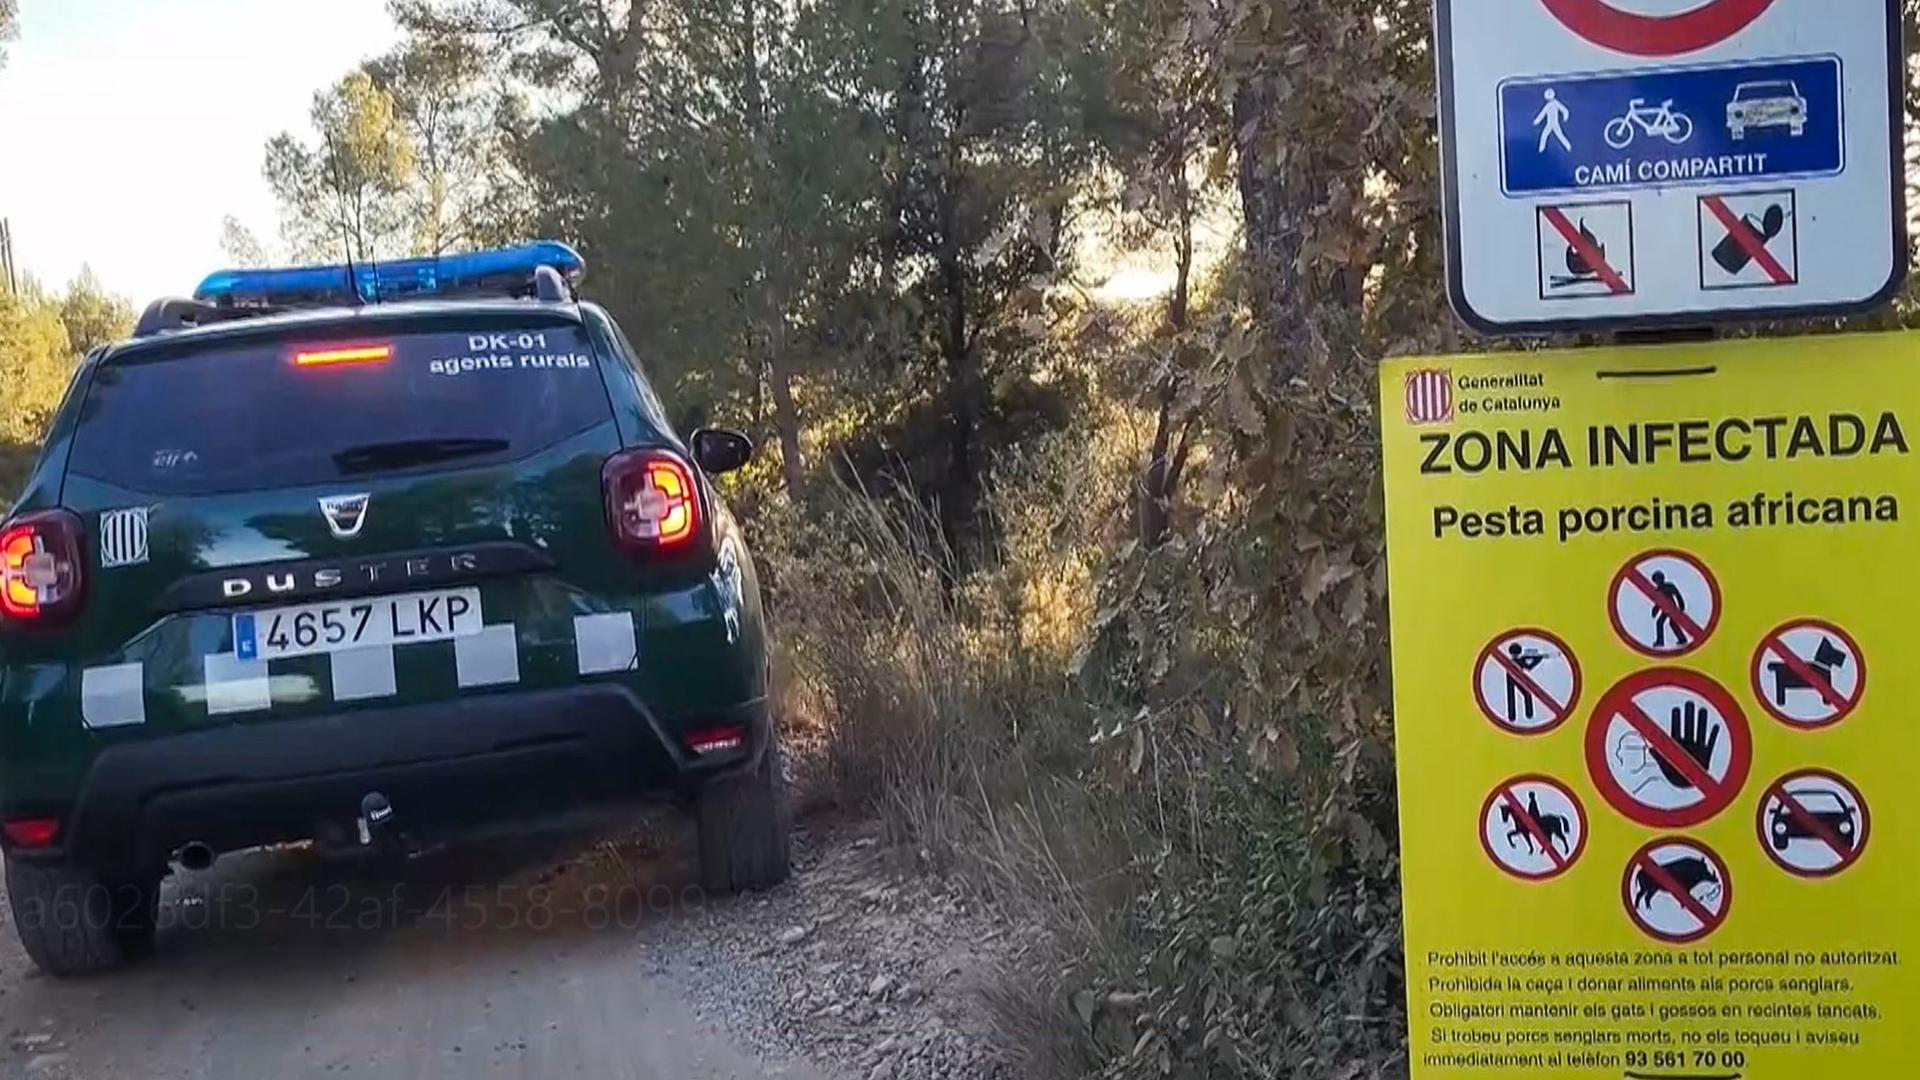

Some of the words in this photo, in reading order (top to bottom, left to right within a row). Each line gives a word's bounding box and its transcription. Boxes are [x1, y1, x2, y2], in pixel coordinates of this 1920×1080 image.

[1574, 160, 1631, 185] CAMÍ
[1638, 153, 1768, 181] COMPARTIT
[468, 333, 546, 352] DK-01
[430, 353, 513, 375] agents
[520, 352, 590, 369] rurals
[1458, 372, 1544, 391] Generalitat
[1459, 397, 1478, 413] de
[1482, 394, 1560, 413] Catalunya
[1420, 427, 1572, 475] ZONA
[1588, 411, 1909, 467] INFECTADA
[1433, 503, 1544, 538] Pesta
[1559, 498, 1713, 541] porcina
[1727, 492, 1898, 528] africana
[223, 553, 476, 597] DUSTER
[267, 605, 372, 650] 4657
[391, 595, 470, 637] LKP
[1427, 951, 1487, 966] Prohibit
[1492, 950, 1546, 966] l'accés
[1551, 955, 1560, 966] a
[1566, 952, 1629, 969] aquesta
[1635, 954, 1672, 966] zona
[1678, 954, 1687, 965] a
[1694, 950, 1713, 965] tot
[1719, 950, 1789, 968] personal
[1795, 953, 1816, 965] no
[1429, 976, 1502, 991] Prohibida
[1508, 975, 1521, 991] la
[1526, 978, 1563, 995] caça
[1577, 976, 1623, 992] donar
[1628, 975, 1696, 992] aliments
[1701, 976, 1723, 991] als
[1729, 978, 1774, 995] porcs
[1779, 976, 1854, 996] senglars.
[1430, 1002, 1504, 1021] Obligatori
[1510, 1002, 1578, 1018] mantenir
[1583, 1002, 1606, 1018] els
[1611, 1003, 1645, 1021] gats
[1659, 1005, 1717, 1022] gossos
[1721, 1005, 1742, 1018] en
[1748, 1003, 1812, 1019] recintes
[1431, 1027, 1447, 1043] Si
[1452, 1028, 1501, 1043] trobeu
[1506, 1031, 1549, 1046] porcs
[1554, 1028, 1622, 1046] senglars
[1681, 1030, 1703, 1043] no
[1706, 1029, 1730, 1044] els
[1735, 1029, 1791, 1046] toqueu
[1806, 1029, 1859, 1044] aviseu
[1424, 1052, 1544, 1068] immediatament
[1550, 1052, 1562, 1068] al
[1567, 1051, 1620, 1067] telèfon
[1625, 1050, 1648, 1067] 93
[1653, 1051, 1686, 1067] 561
[1693, 1051, 1716, 1067] 70
